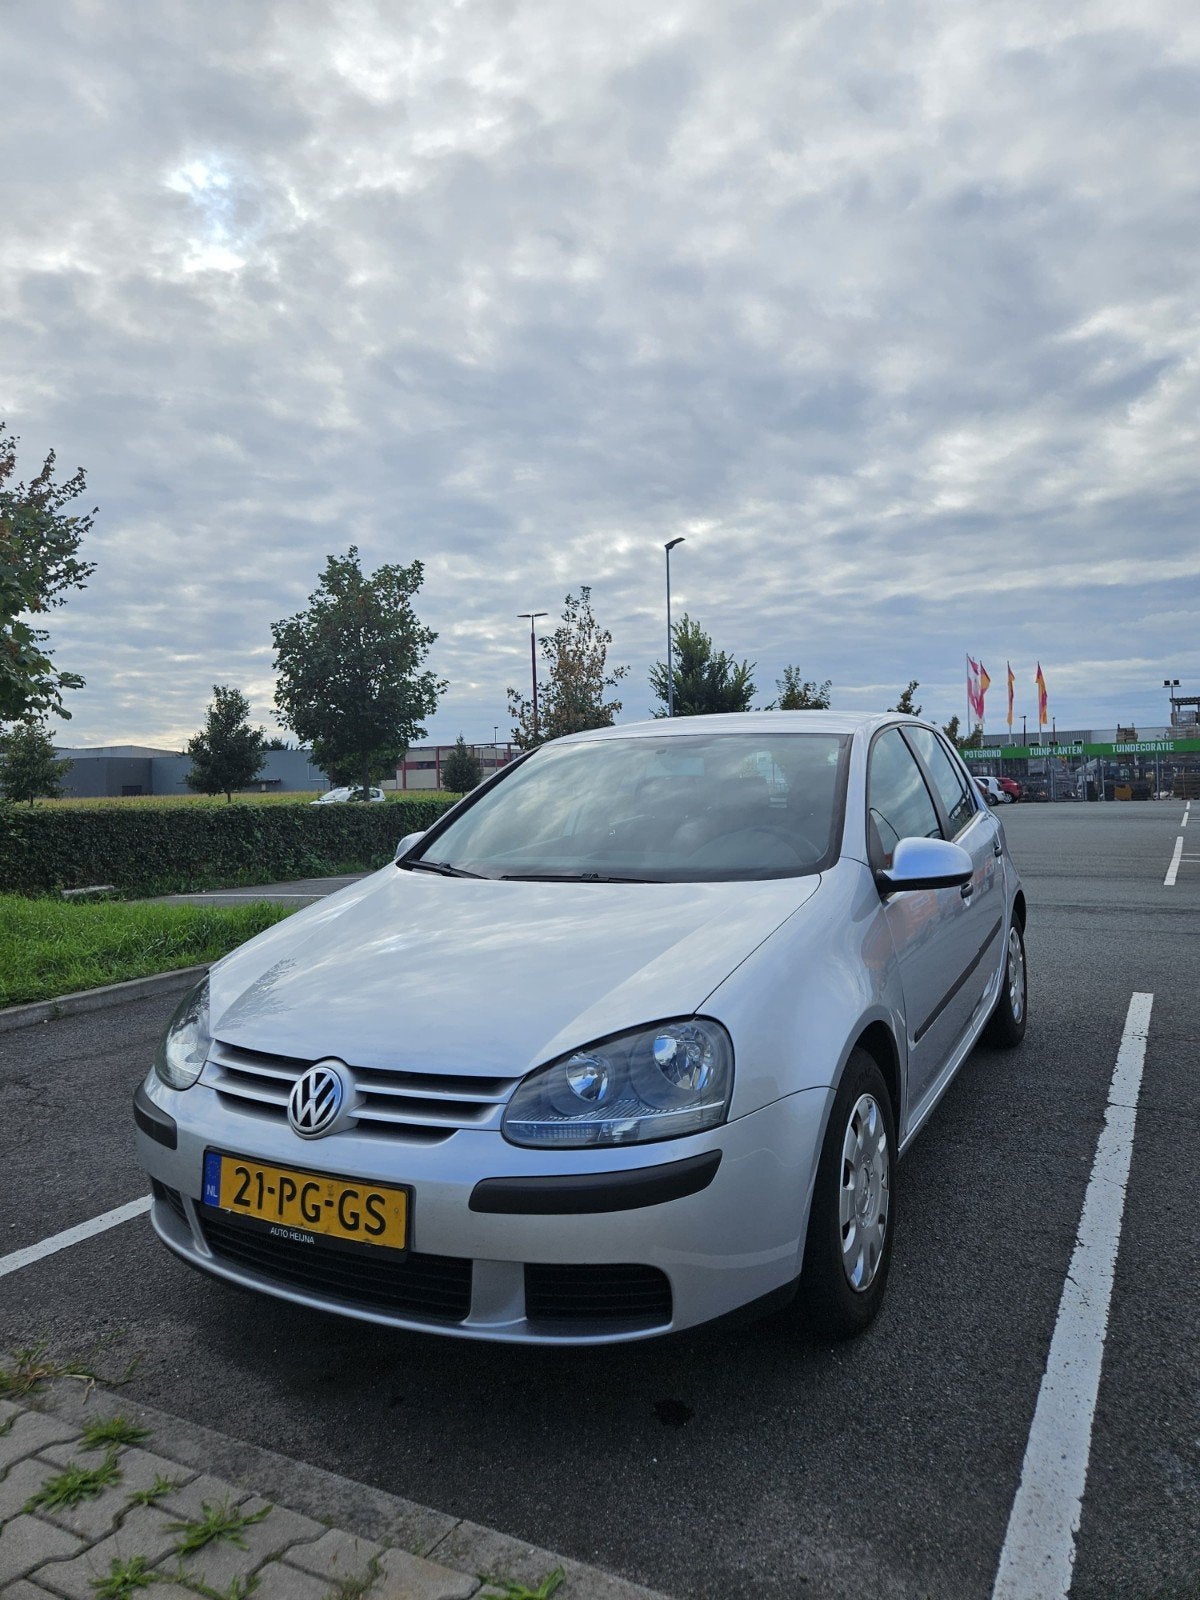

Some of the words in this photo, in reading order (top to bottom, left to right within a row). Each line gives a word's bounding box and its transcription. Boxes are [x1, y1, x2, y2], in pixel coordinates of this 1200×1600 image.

[964, 749, 1002, 758] POTGROND
[1111, 742, 1174, 753] TUINDECORATIE
[206, 1186, 218, 1198] NL
[233, 1166, 387, 1236] 21-PG-GS
[270, 1227, 288, 1238] AUTO
[290, 1232, 315, 1245] HEIJNA
